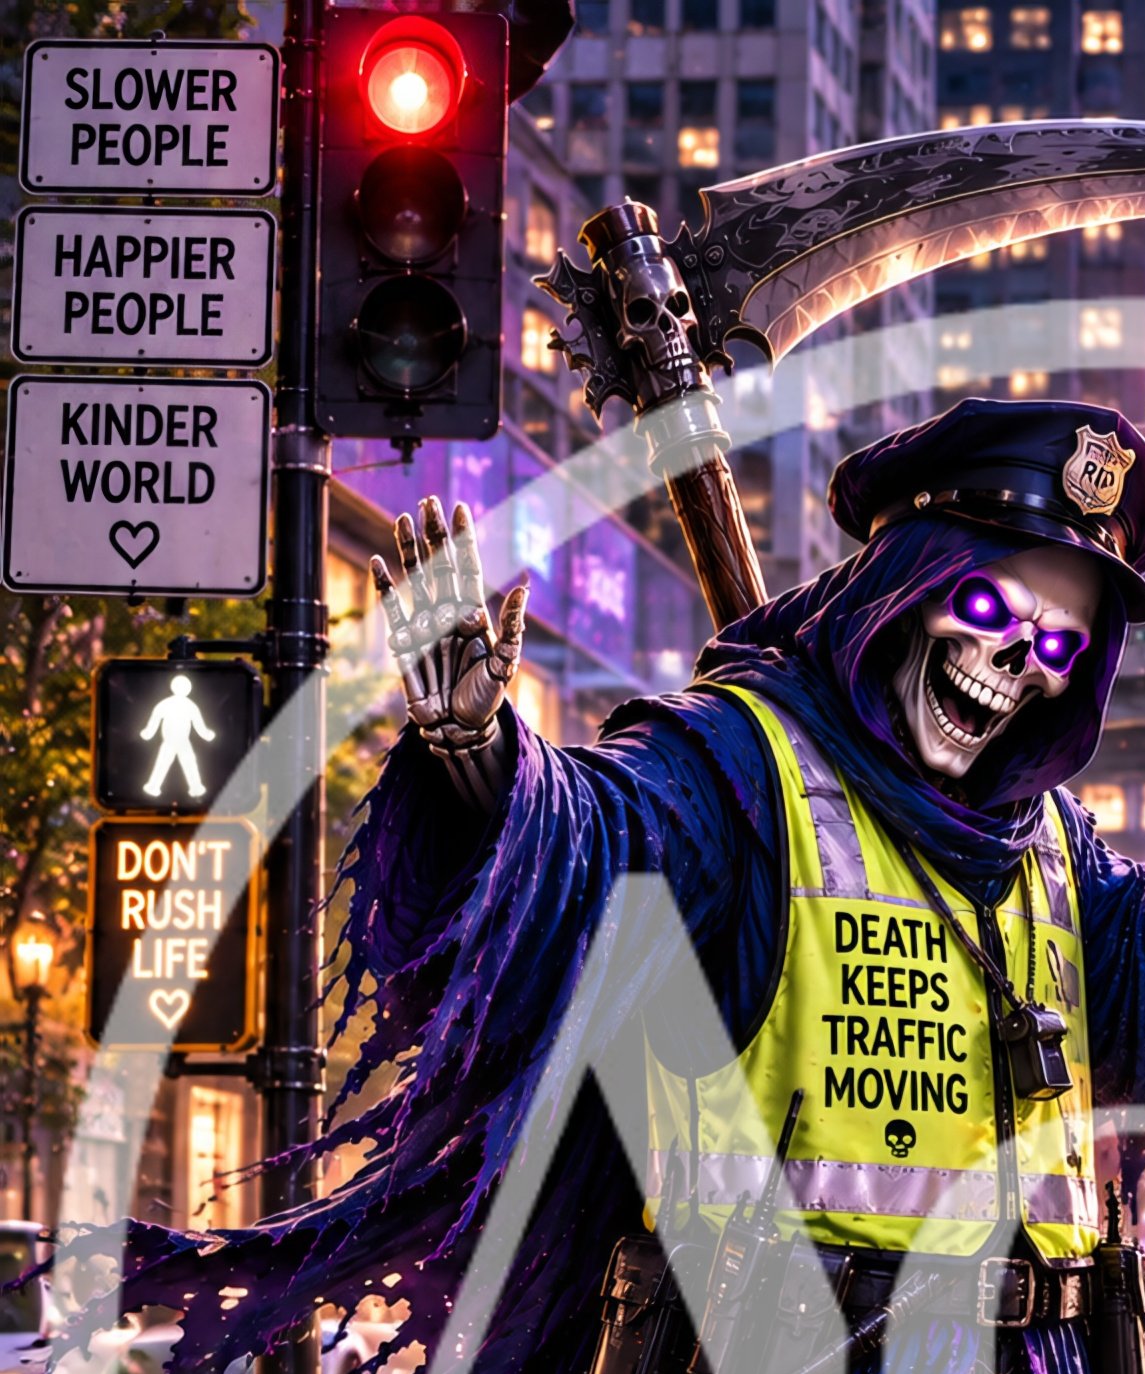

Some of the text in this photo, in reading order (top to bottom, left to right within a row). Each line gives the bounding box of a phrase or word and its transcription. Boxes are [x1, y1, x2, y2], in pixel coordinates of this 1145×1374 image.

[64, 67, 237, 111] SLOWER
[70, 123, 229, 167] PEOPLE
[54, 234, 235, 280] HAPPIER
[63, 291, 224, 337] PEOPLE
[60, 402, 218, 447] KINDER
[60, 459, 215, 504] WORLD
[116, 840, 231, 882] DON'T
[121, 889, 222, 931] RUSH
[132, 938, 208, 979] LIFE
[834, 911, 948, 963] DEATH
[841, 963, 950, 1012] KEEPS
[822, 1014, 968, 1063] TRAFFIC
[824, 1066, 969, 1115] MOVING
